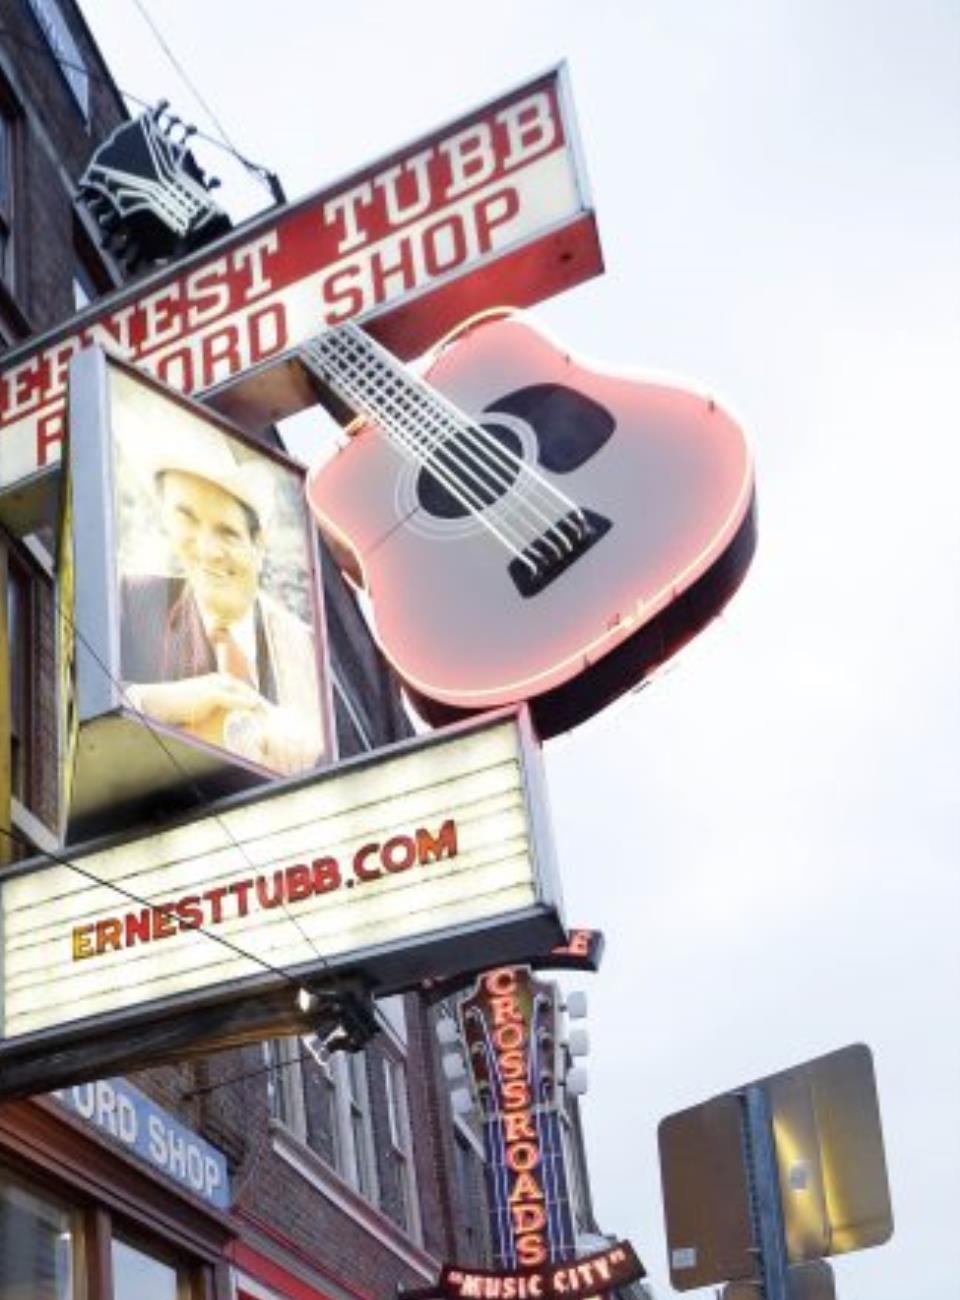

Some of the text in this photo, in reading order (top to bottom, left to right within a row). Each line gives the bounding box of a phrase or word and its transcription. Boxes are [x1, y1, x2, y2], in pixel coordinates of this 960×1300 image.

[2, 86, 559, 424] ERNEST TUBB
[36, 180, 520, 467] RORD SHOP
[71, 819, 459, 962] ERNESTTUBB.COM
[149, 1114, 221, 1196] SHOP
[485, 968, 547, 1266] CROSSROADS
